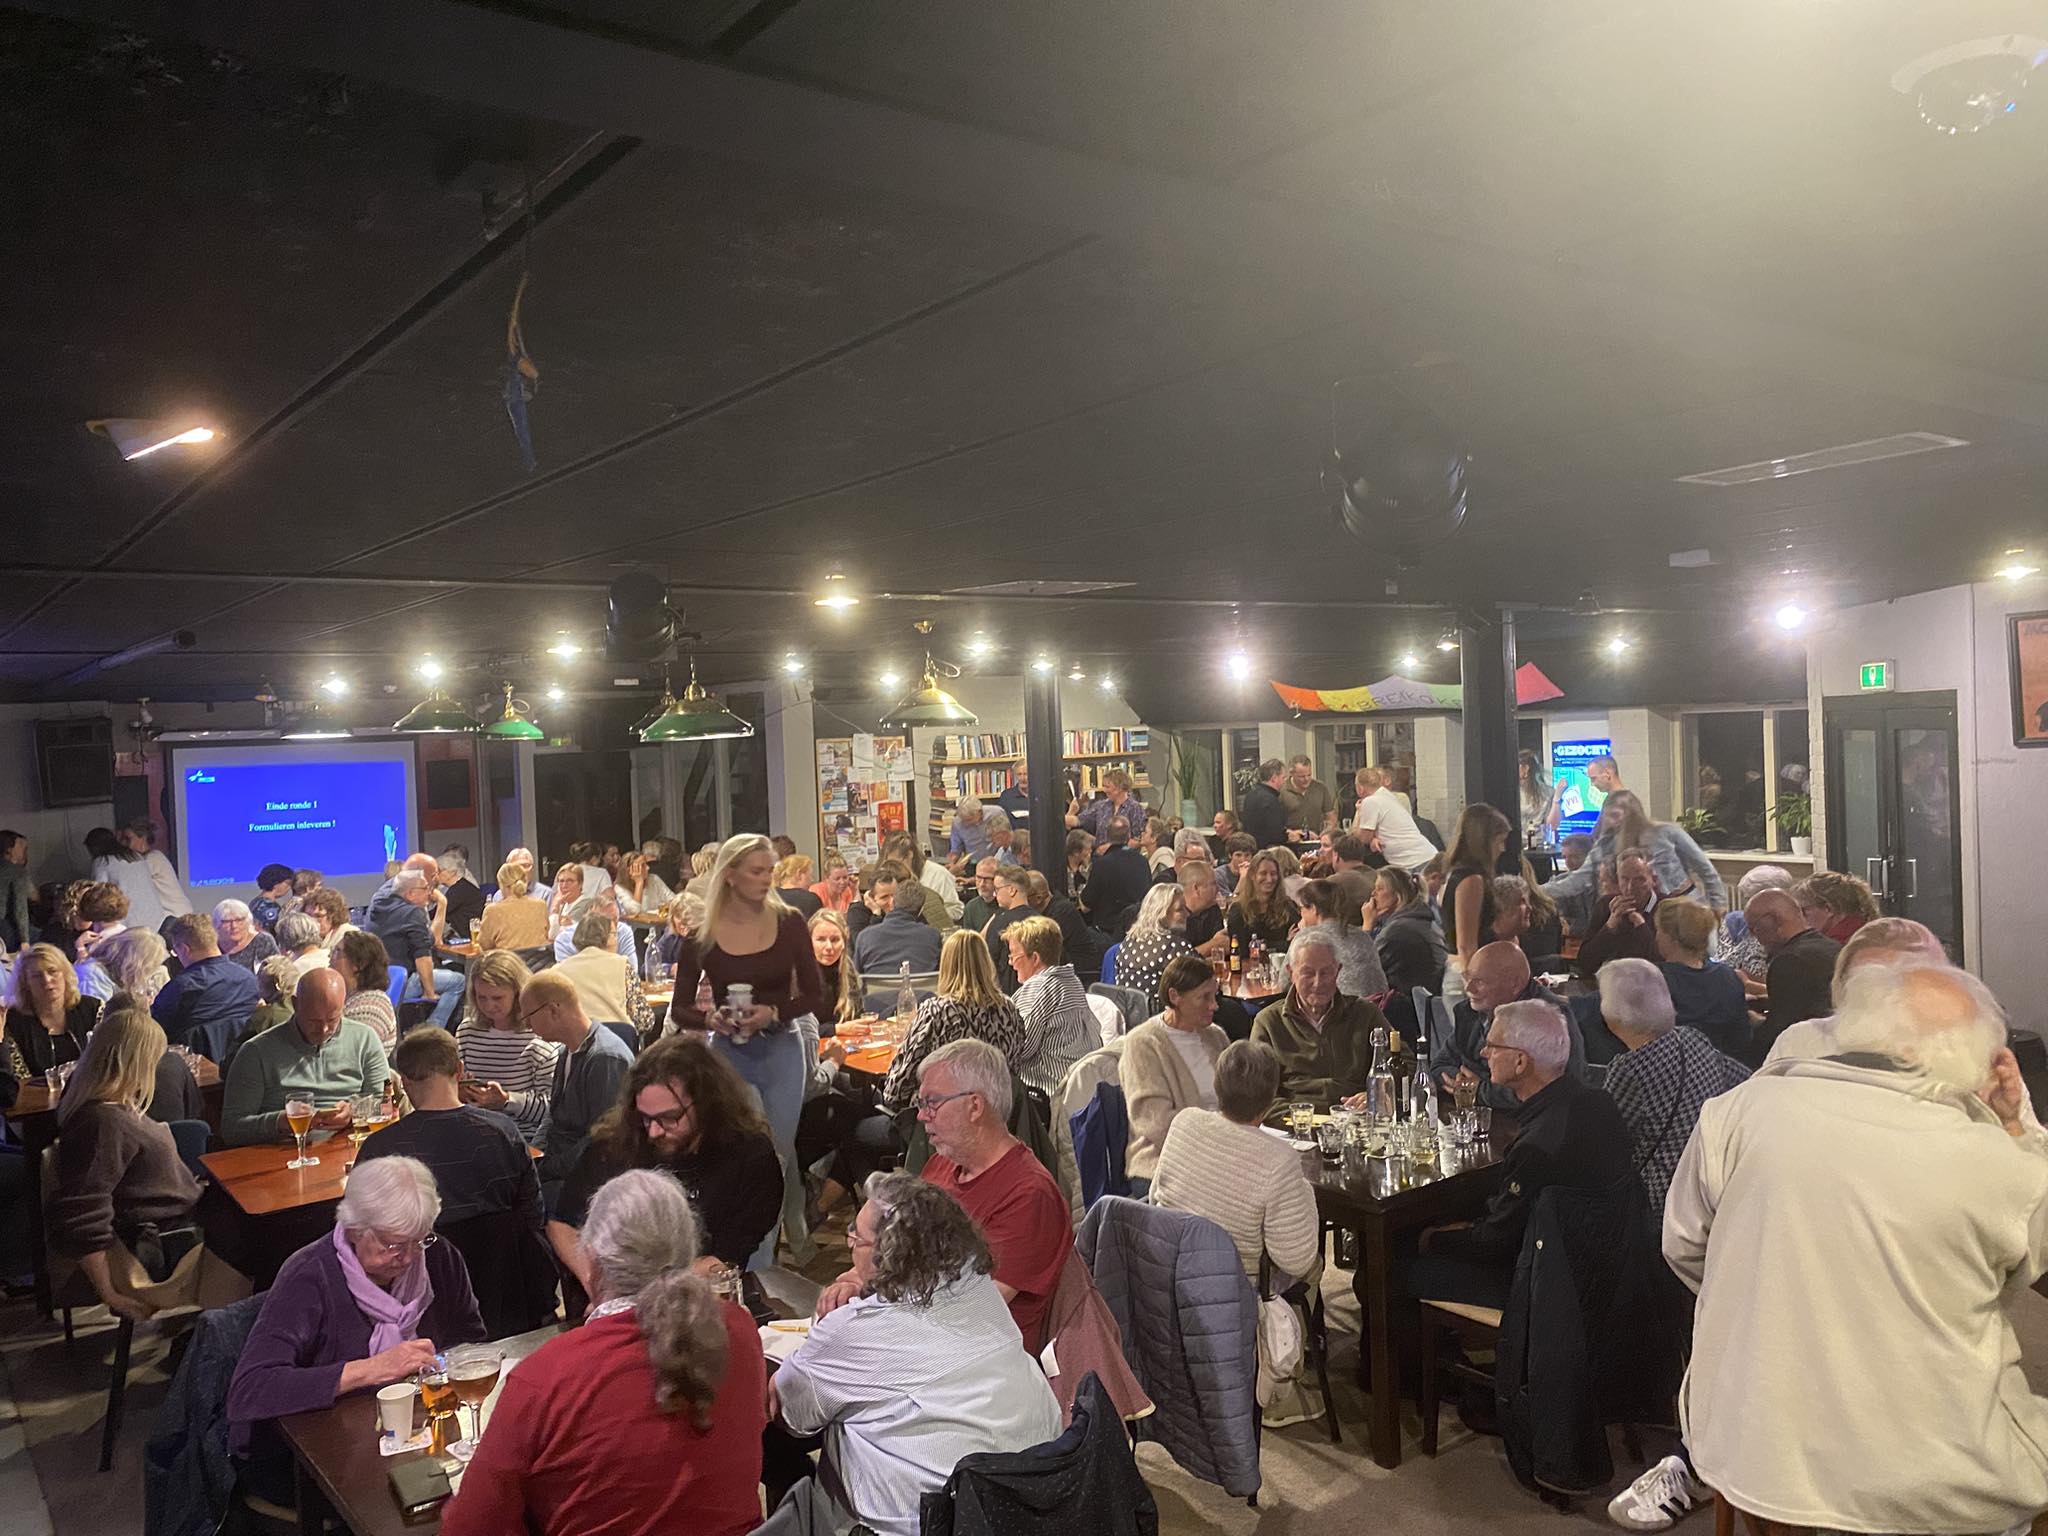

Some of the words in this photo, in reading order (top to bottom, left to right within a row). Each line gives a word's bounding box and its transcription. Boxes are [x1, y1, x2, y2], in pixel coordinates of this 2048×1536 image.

[266, 802, 289, 811] Einde
[290, 801, 312, 809] ronde
[249, 822, 296, 832] Formulieren
[297, 821, 332, 830] inleveren
